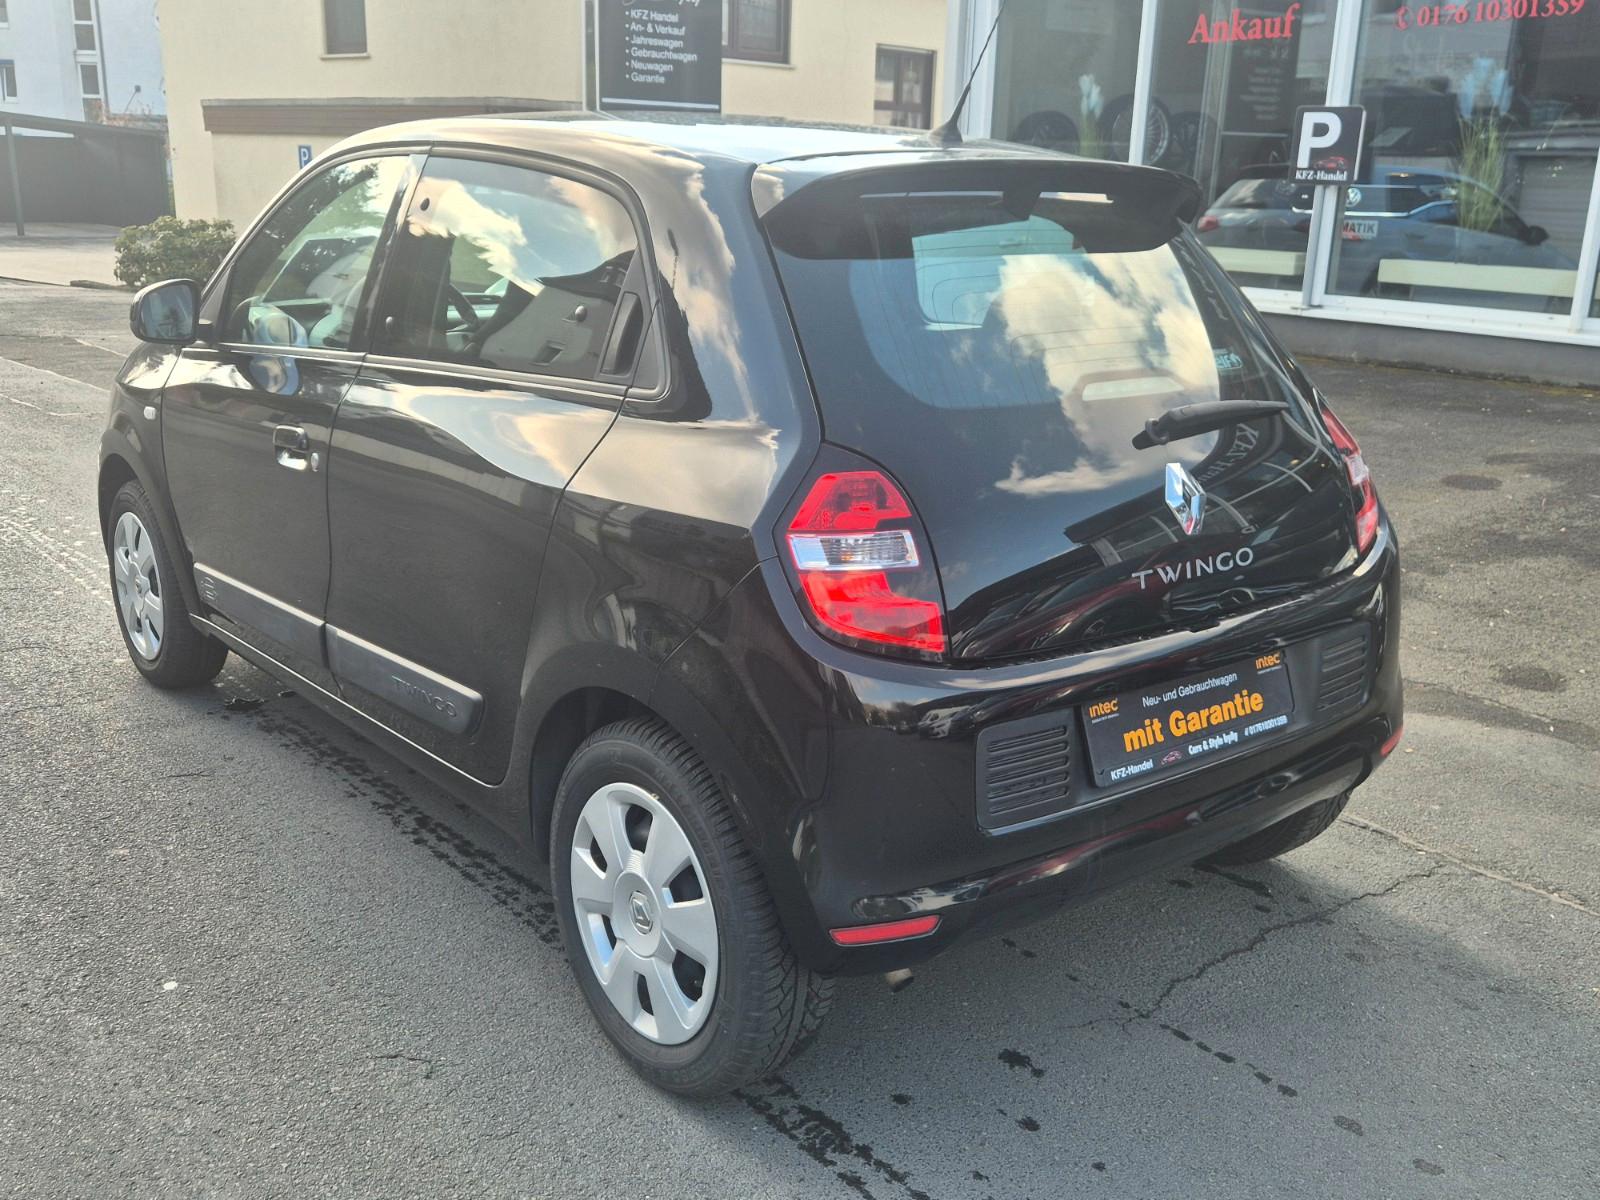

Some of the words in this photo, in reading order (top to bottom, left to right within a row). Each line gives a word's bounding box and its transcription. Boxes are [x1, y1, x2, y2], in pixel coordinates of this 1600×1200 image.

[630, 8, 649, 20] KFZ
[650, 11, 679, 22] Handel
[1187, 3, 1300, 45] Ankauf
[1416, 1, 1470, 27] 0176
[630, 21, 645, 32] An-
[646, 22, 654, 33] &
[654, 24, 686, 36] Verkauf
[631, 34, 684, 49] Jahreswagen
[631, 47, 698, 62] Gebrauchtwagen
[631, 59, 673, 73] Neuwagen
[631, 72, 665, 83] Garantie
[1296, 111, 1342, 169] P
[300, 147, 310, 167] P
[1295, 169, 1348, 183] KFZ-Handel
[1131, 547, 1254, 589] TWINGO
[1255, 652, 1281, 670] intec
[1142, 695, 1162, 707] Neu-
[1162, 688, 1178, 702] und
[1178, 672, 1238, 697] Gebrauchtwagen
[1088, 698, 1119, 719] intec
[1123, 717, 1164, 753] mit
[1169, 689, 1264, 738] Garantie
[1188, 744, 1203, 756] Cars
[1202, 740, 1209, 751] &
[1208, 735, 1224, 749] Style
[1110, 759, 1154, 781] KFZ-Handel
